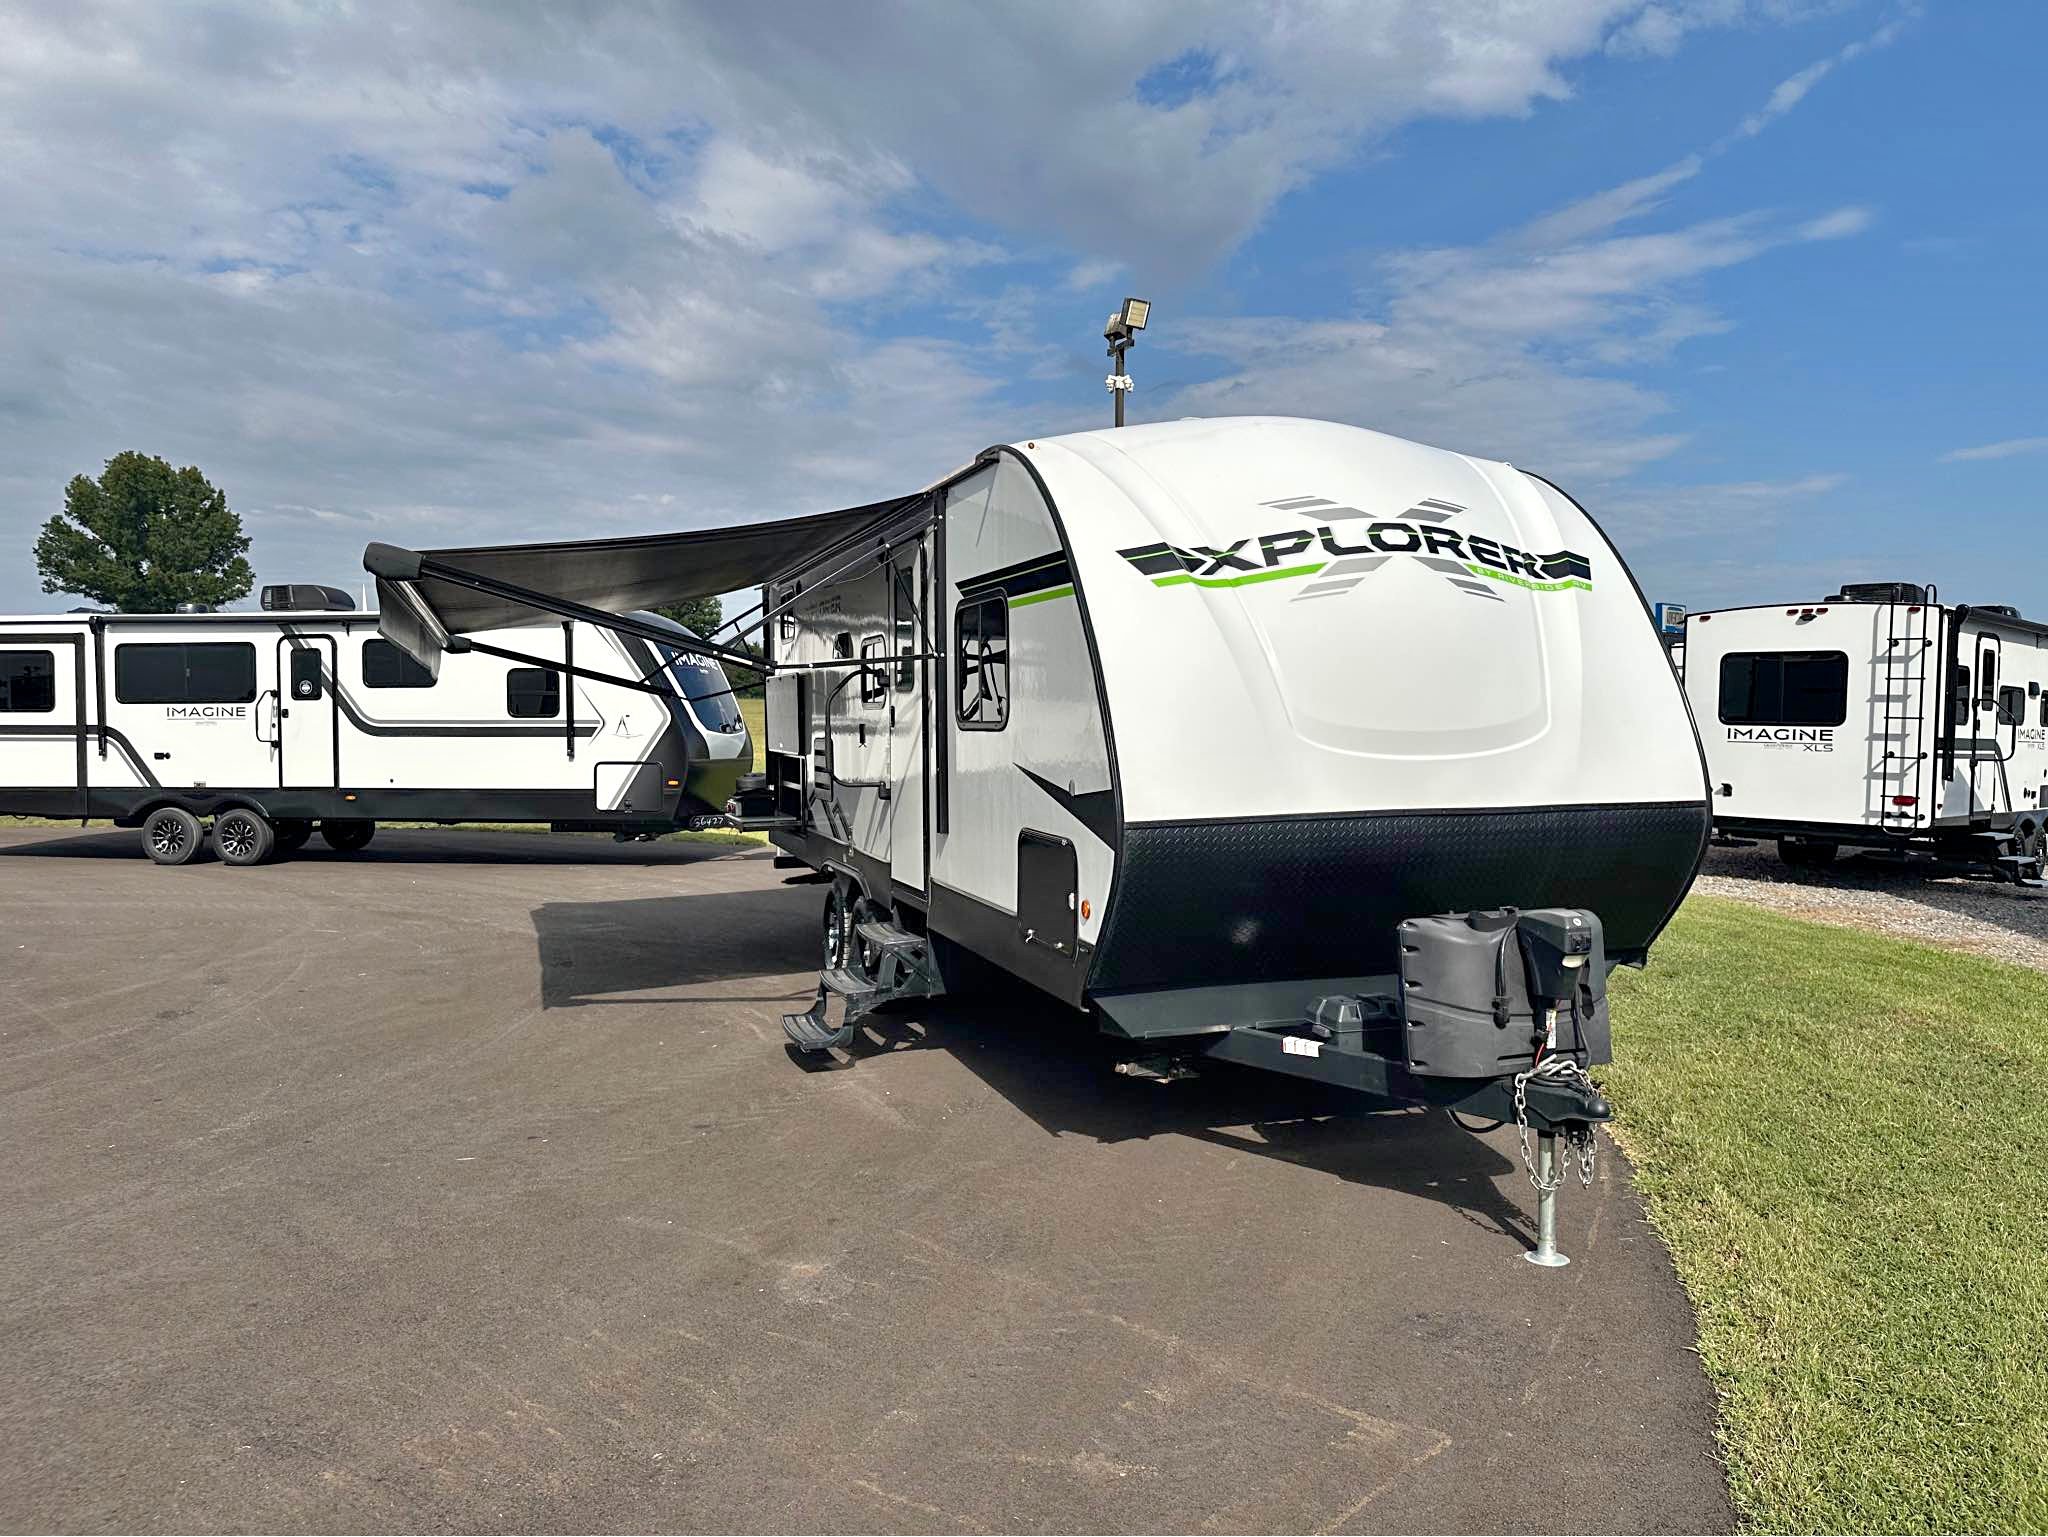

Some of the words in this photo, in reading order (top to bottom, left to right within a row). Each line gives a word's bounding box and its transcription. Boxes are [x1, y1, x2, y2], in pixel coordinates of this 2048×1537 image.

[1193, 522, 1545, 578] XPLORER
[1476, 567, 1493, 577] BY
[1497, 572, 1563, 591] RIVERSIDE
[166, 706, 246, 717] IMAGINE
[1727, 728, 1833, 741] IMAGINE
[2018, 728, 2045, 740] IMAGINE
[1803, 744, 1833, 752] XLS
